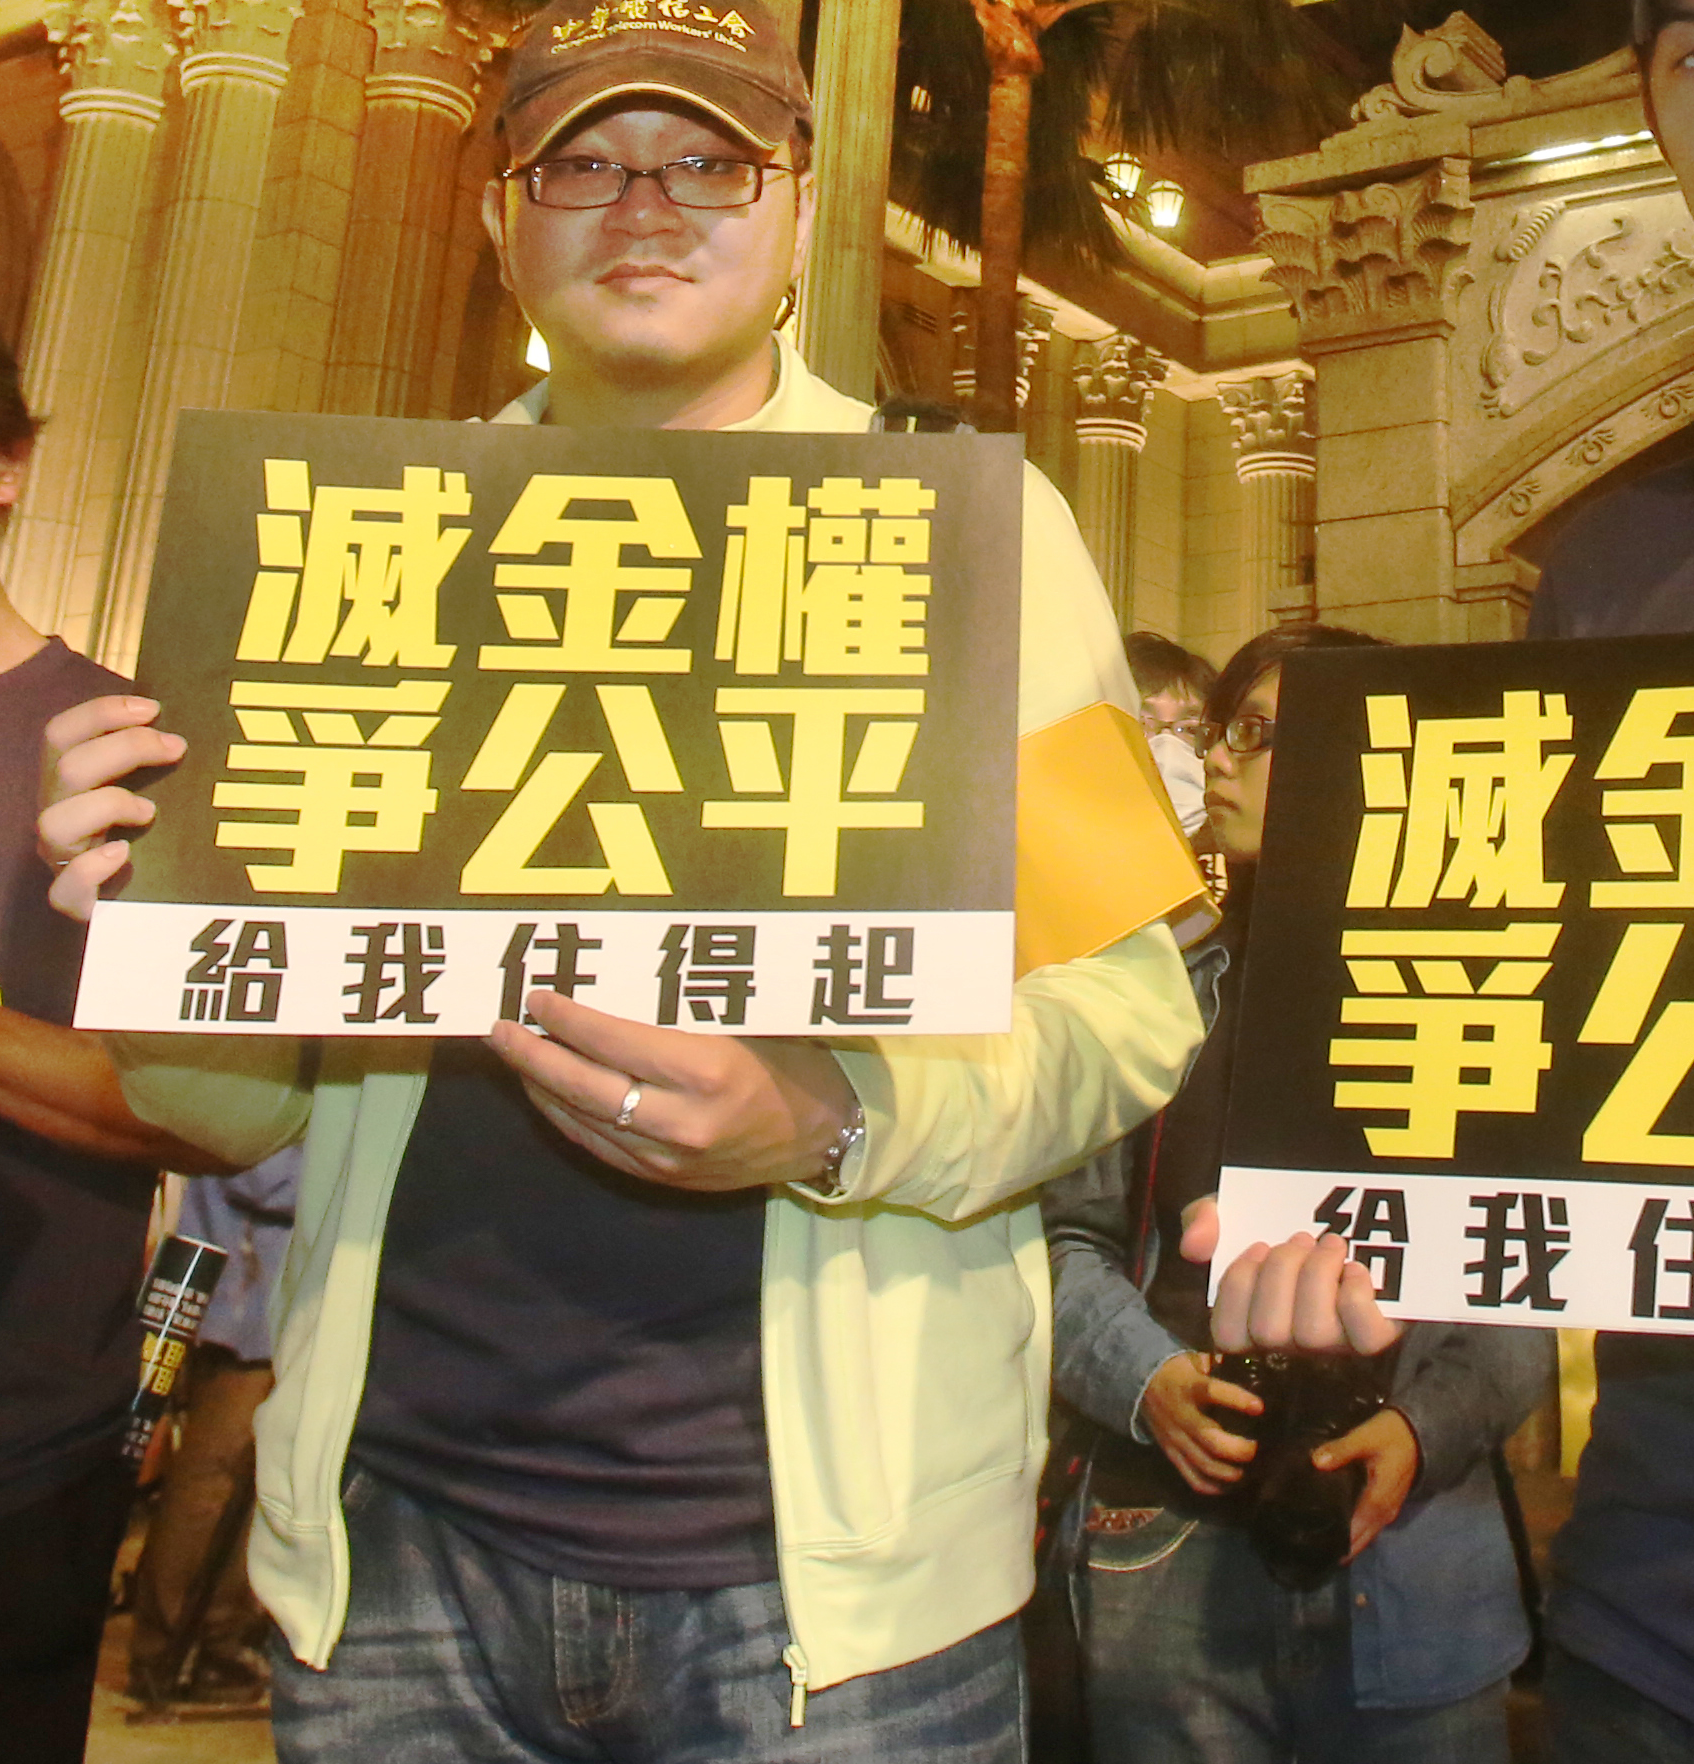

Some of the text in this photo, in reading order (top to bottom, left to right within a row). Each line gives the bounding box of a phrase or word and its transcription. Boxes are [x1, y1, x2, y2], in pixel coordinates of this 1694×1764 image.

[236, 457, 938, 677] 滅金權
[211, 679, 927, 898] 爭公平
[179, 918, 917, 1027] 給我住得起
